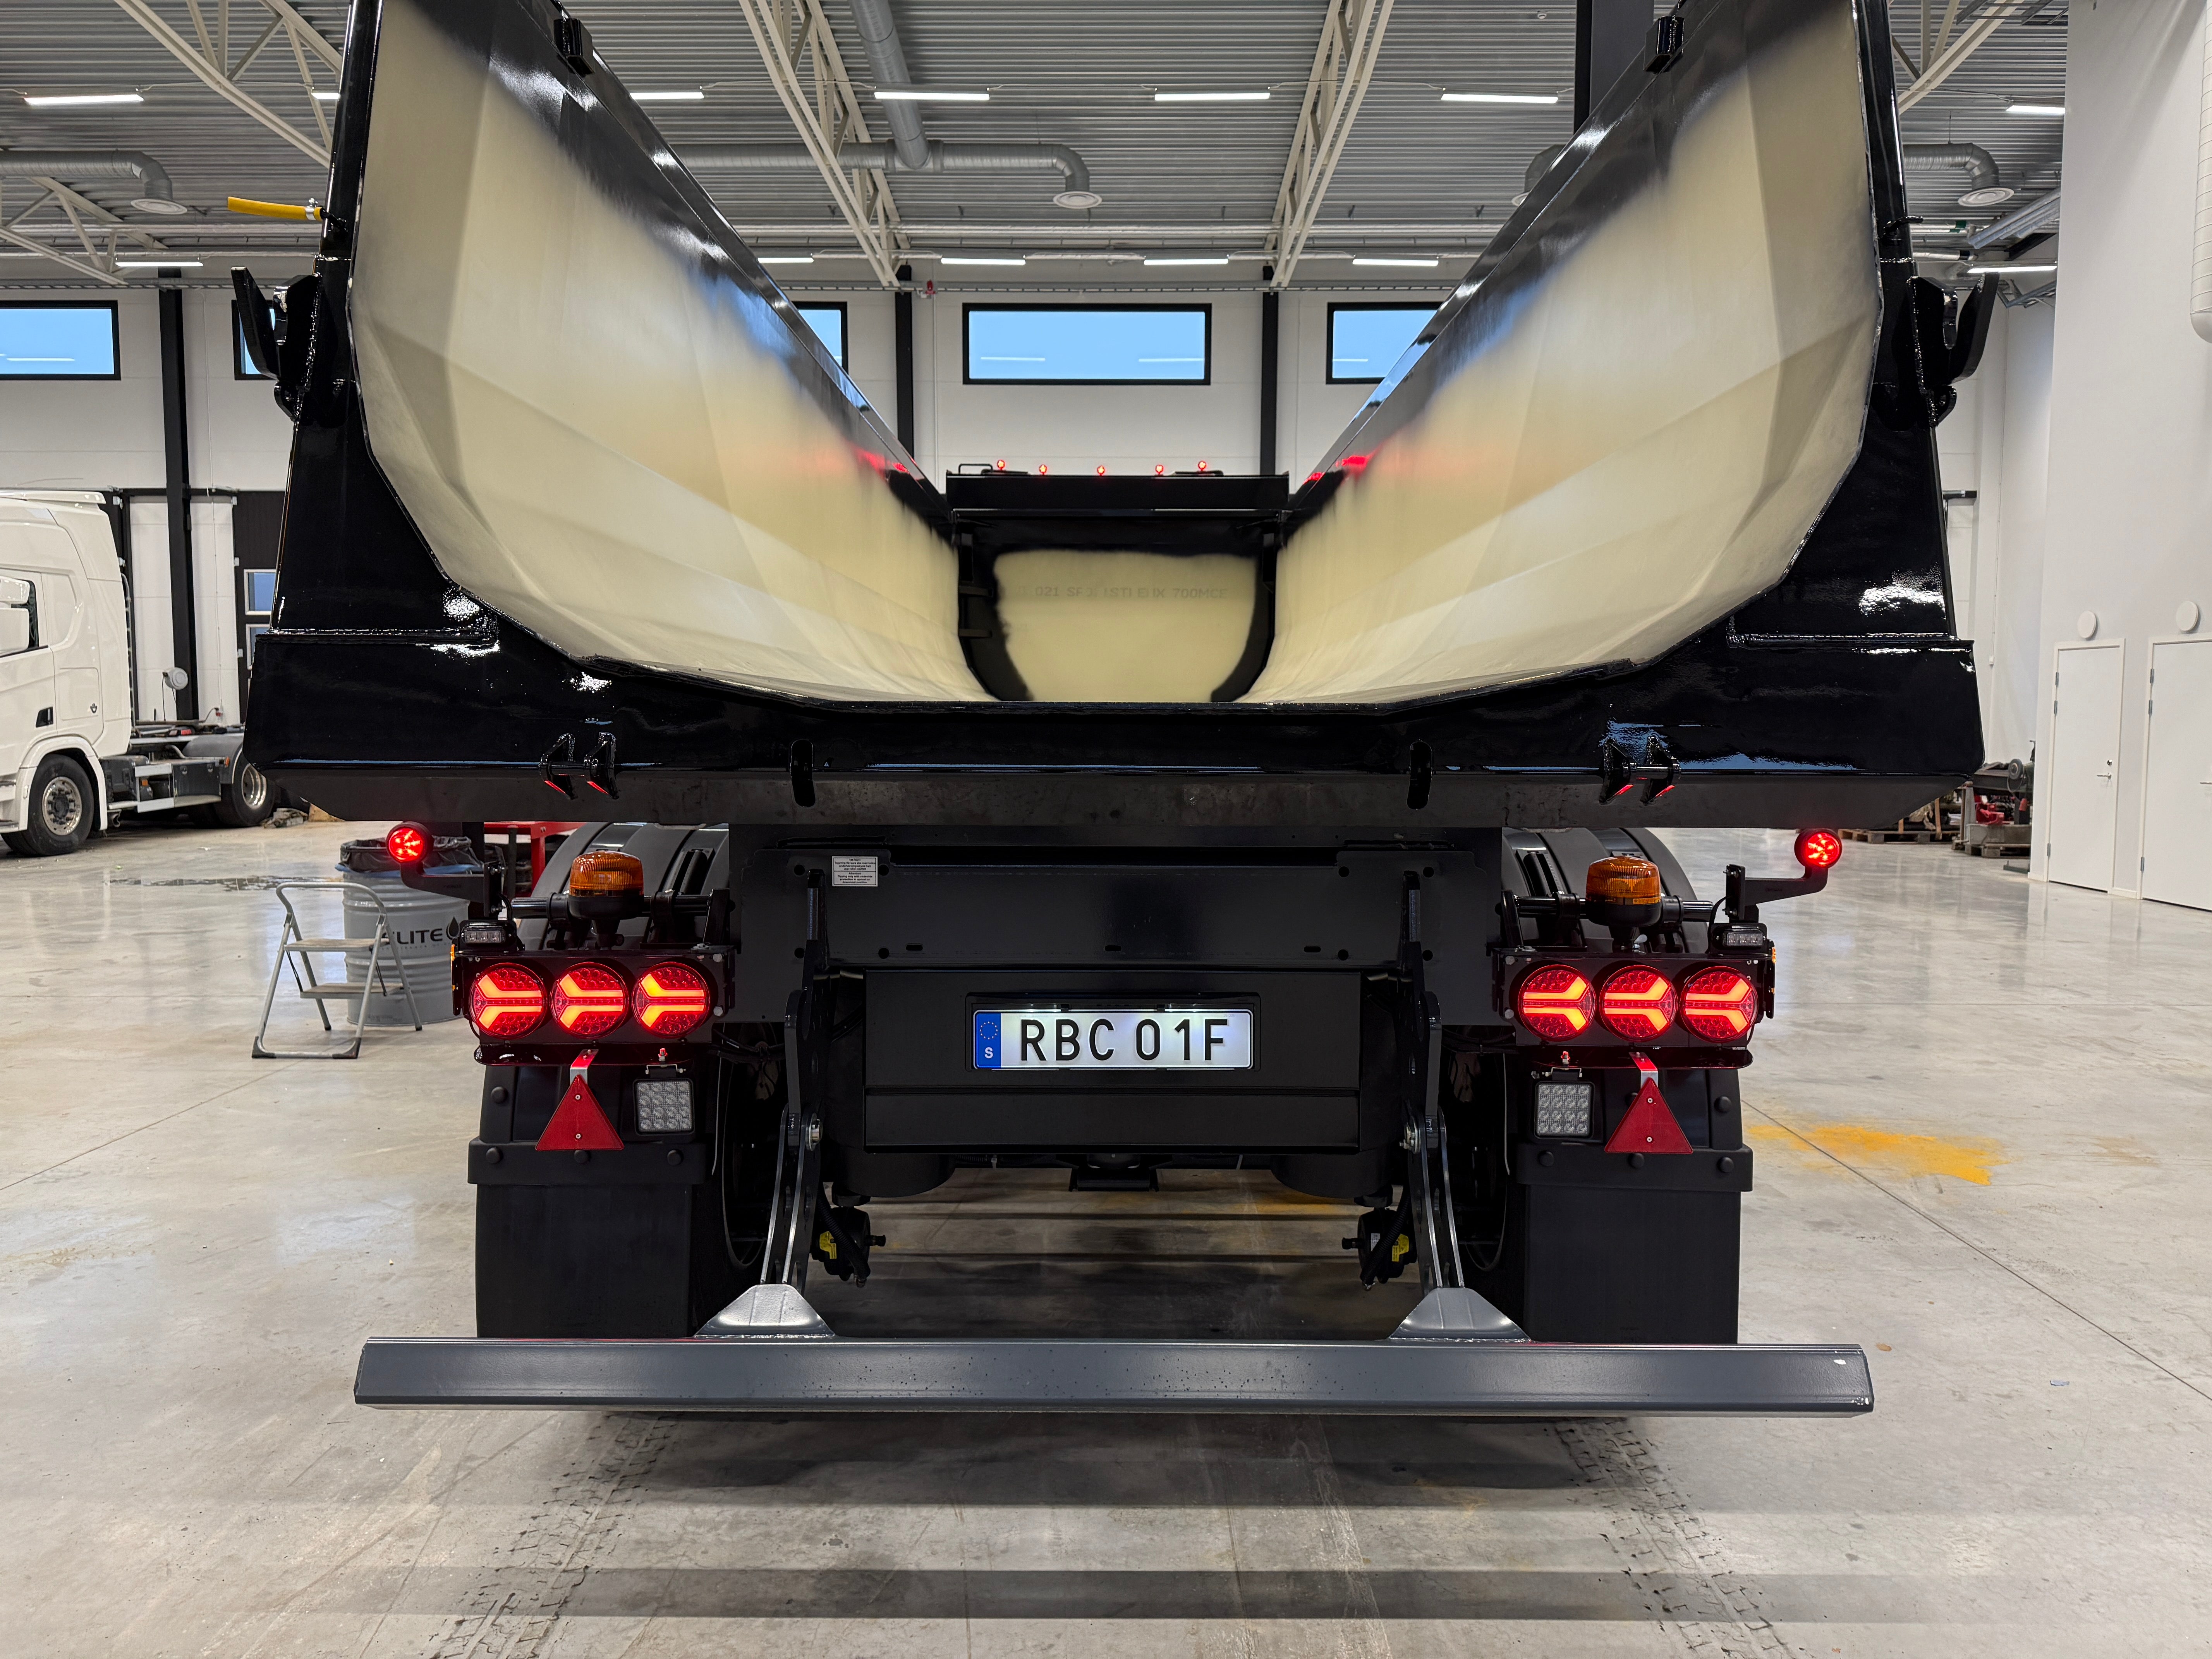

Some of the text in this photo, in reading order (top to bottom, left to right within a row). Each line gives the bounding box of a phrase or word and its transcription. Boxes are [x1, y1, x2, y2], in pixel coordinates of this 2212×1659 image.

[1035, 586, 1059, 597] 021
[1021, 1018, 1228, 1061] RBC 01F
[984, 1048, 993, 1059] S
